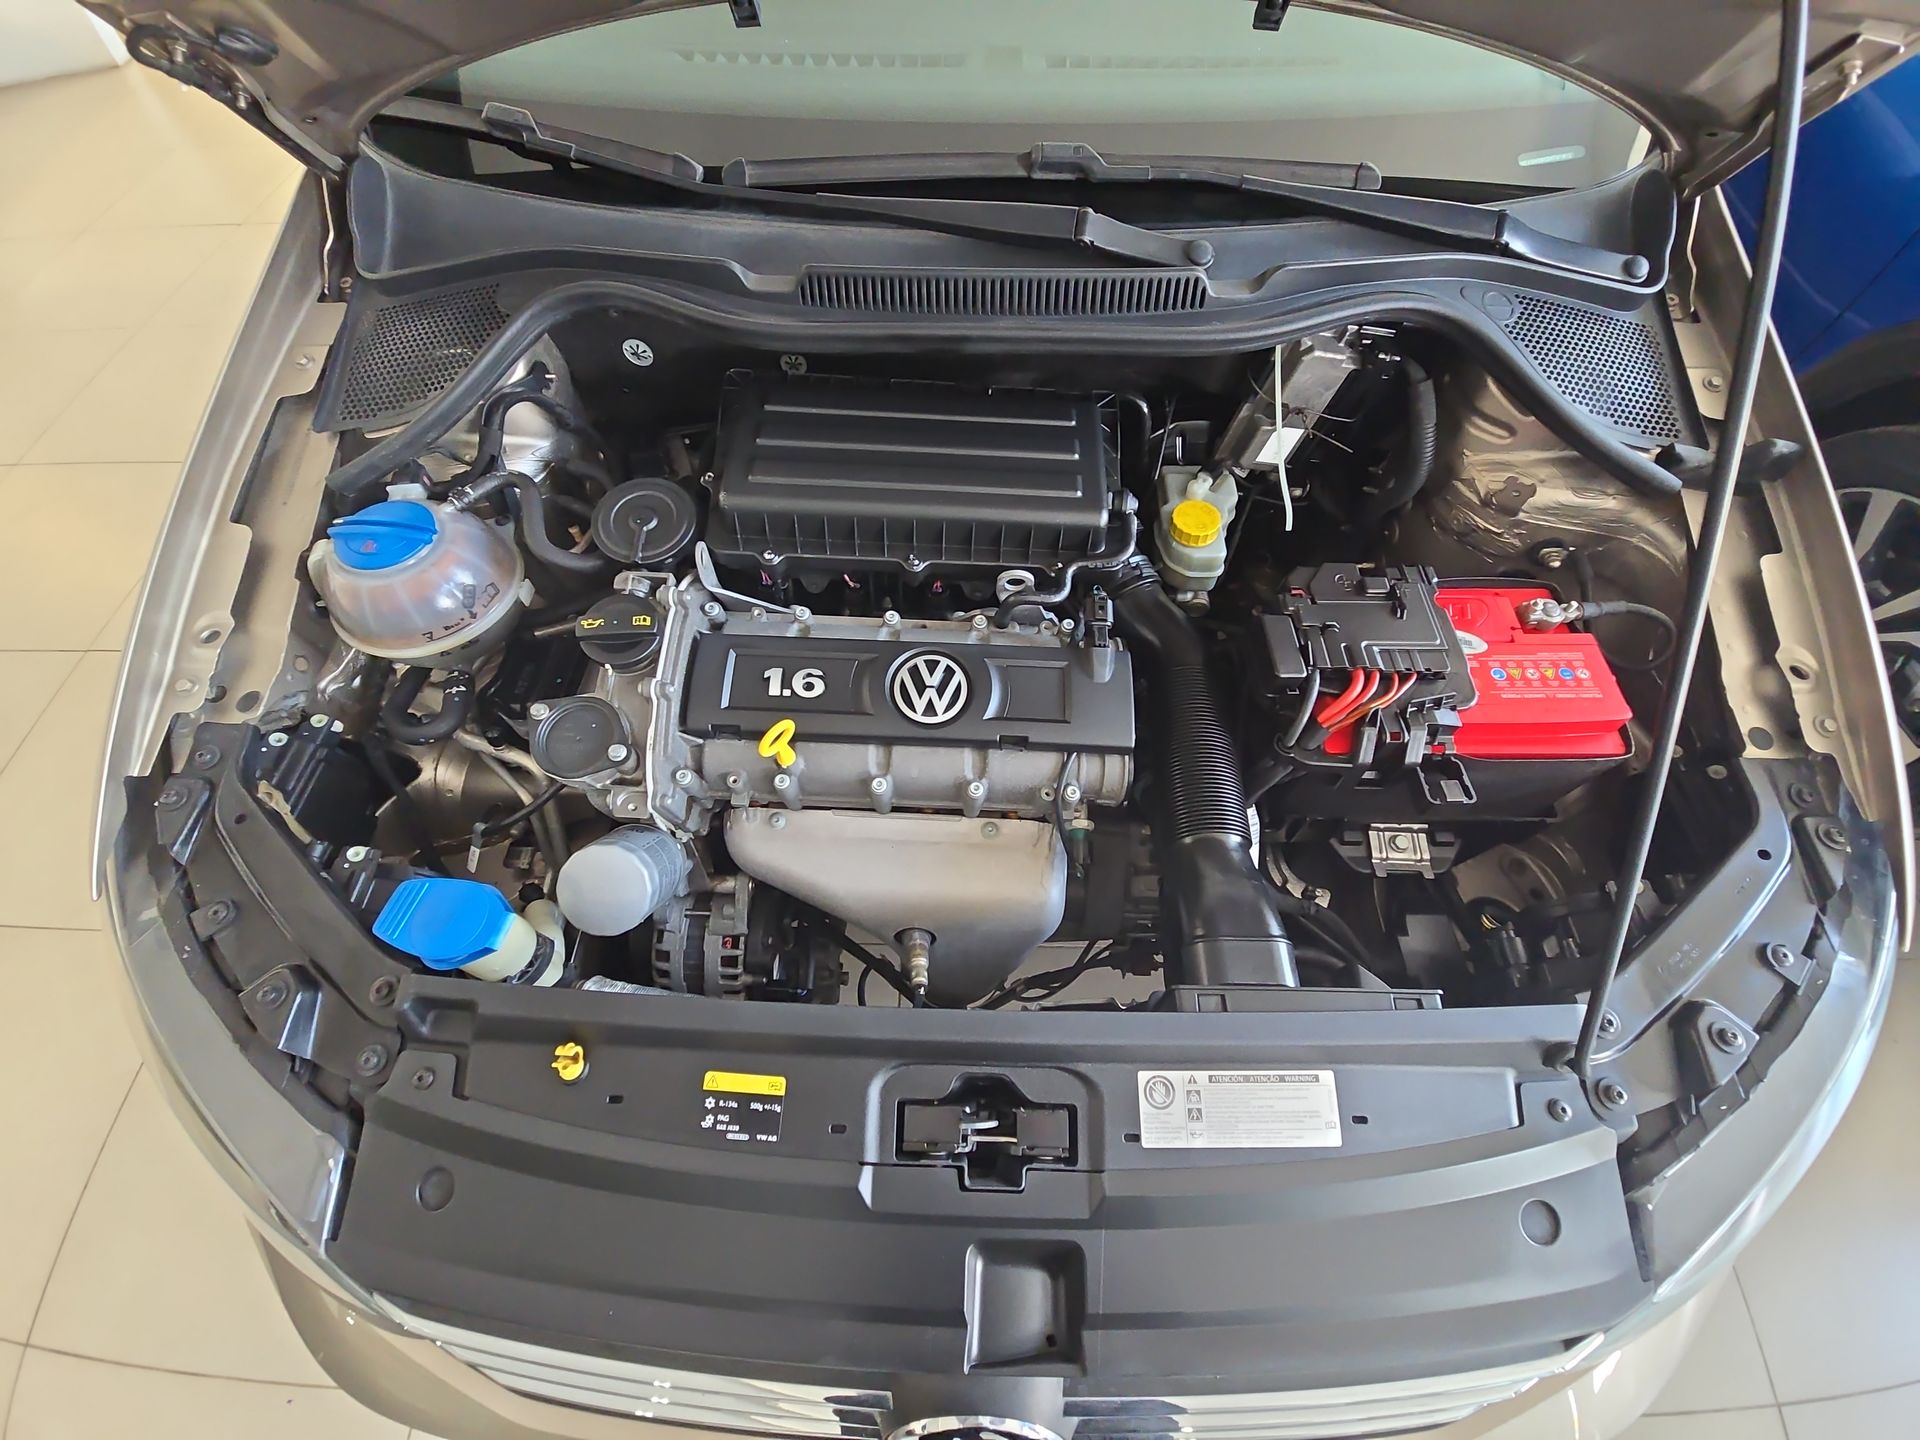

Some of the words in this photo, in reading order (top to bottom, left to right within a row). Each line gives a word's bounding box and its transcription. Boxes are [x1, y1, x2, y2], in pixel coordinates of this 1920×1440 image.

[763, 667, 826, 699] 1.6
[895, 654, 968, 724] VW
[1249, 1074, 1280, 1083] ATENÇÃO
[1284, 1074, 1316, 1082] WARNING
[717, 1114, 729, 1122] PAG
